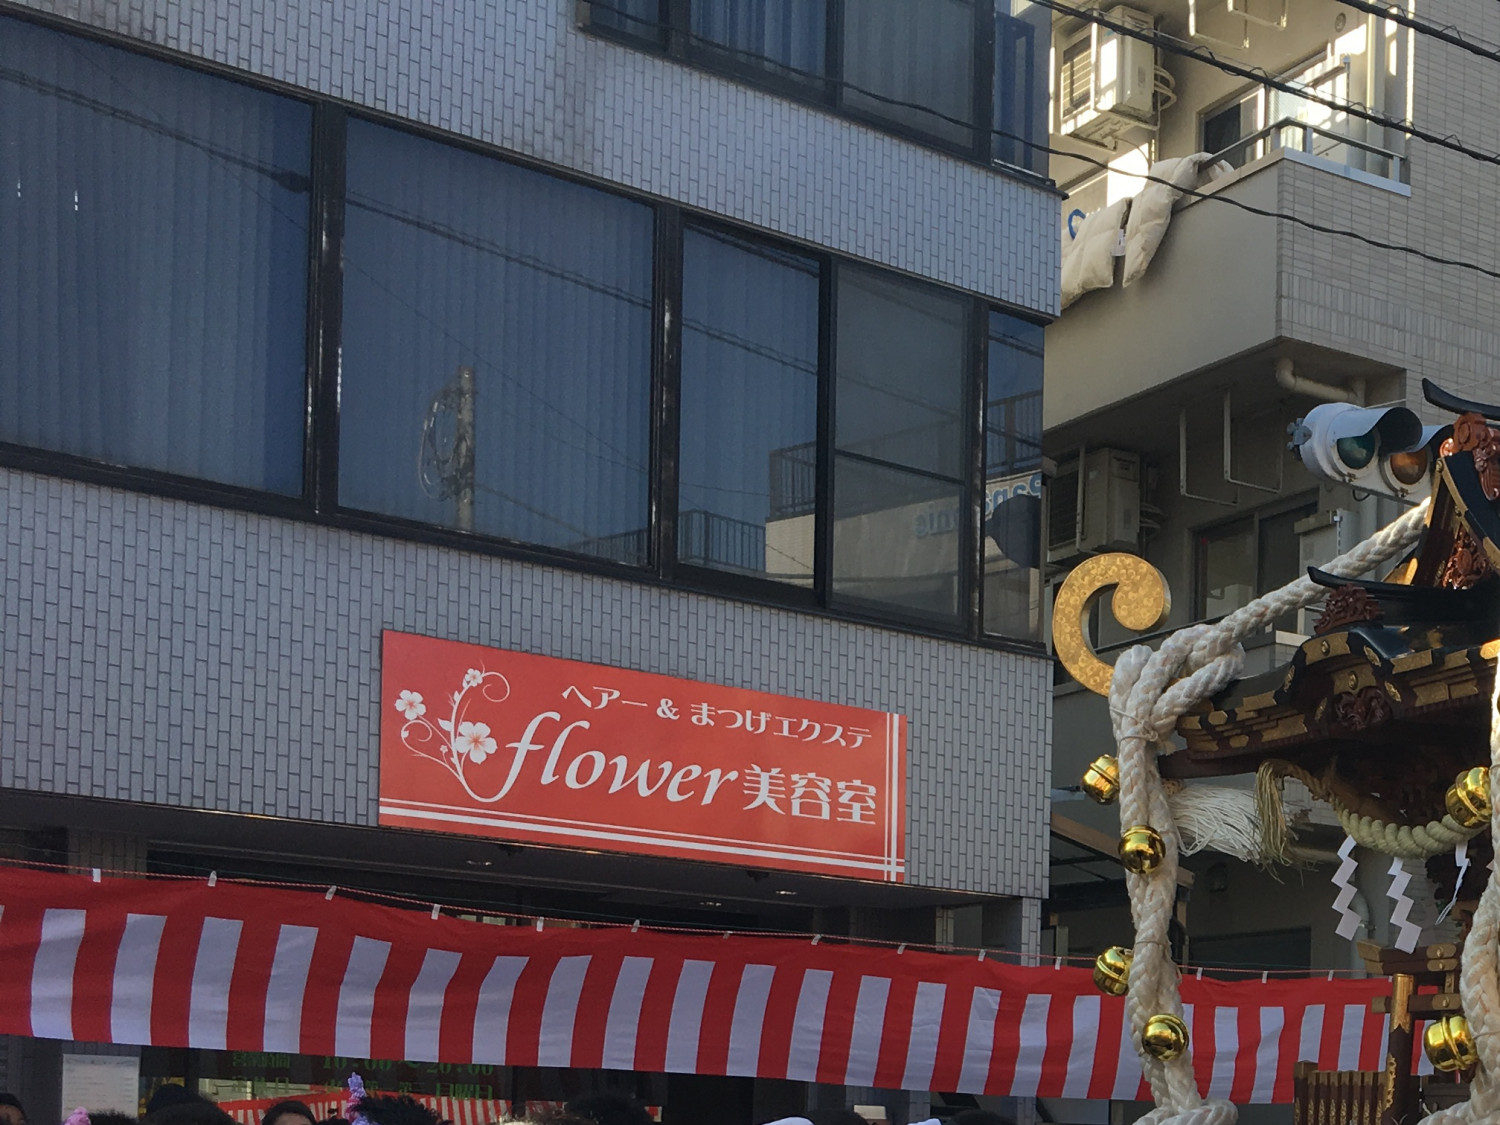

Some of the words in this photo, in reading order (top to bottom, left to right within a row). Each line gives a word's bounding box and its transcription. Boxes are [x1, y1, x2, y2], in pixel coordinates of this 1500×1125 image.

[561, 685, 649, 710] ヘアー
[656, 699, 680, 720] &
[690, 702, 872, 749] まつげエクステ
[490, 711, 739, 806] flower
[743, 764, 877, 825] 美容室
